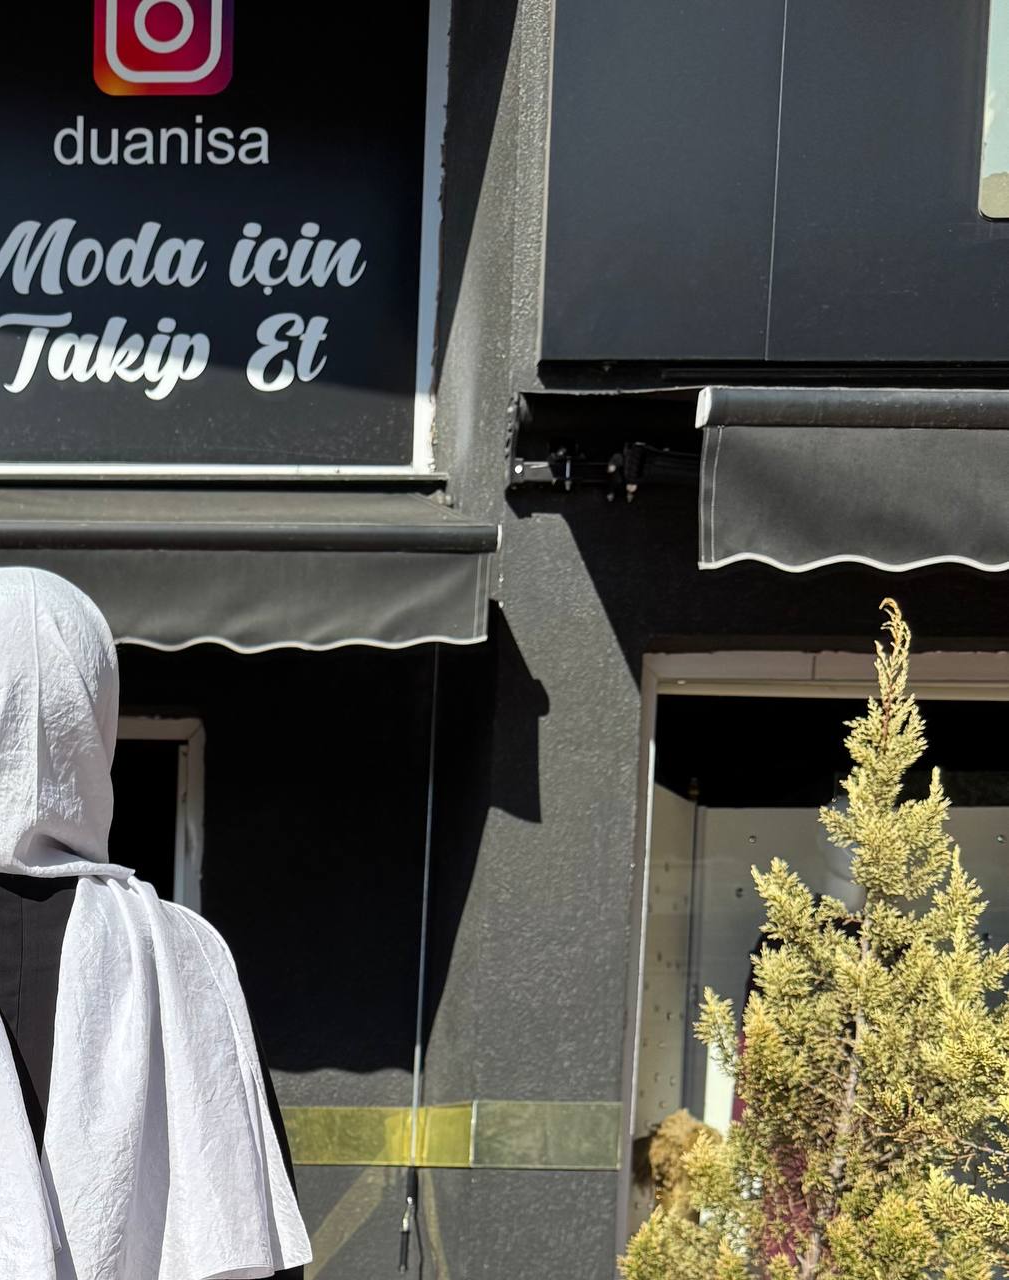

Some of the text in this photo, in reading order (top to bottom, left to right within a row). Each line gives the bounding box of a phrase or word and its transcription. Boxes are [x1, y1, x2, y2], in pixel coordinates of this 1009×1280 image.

[53, 114, 270, 166] duanisa
[228, 221, 367, 297] için
[246, 312, 330, 392] Et
